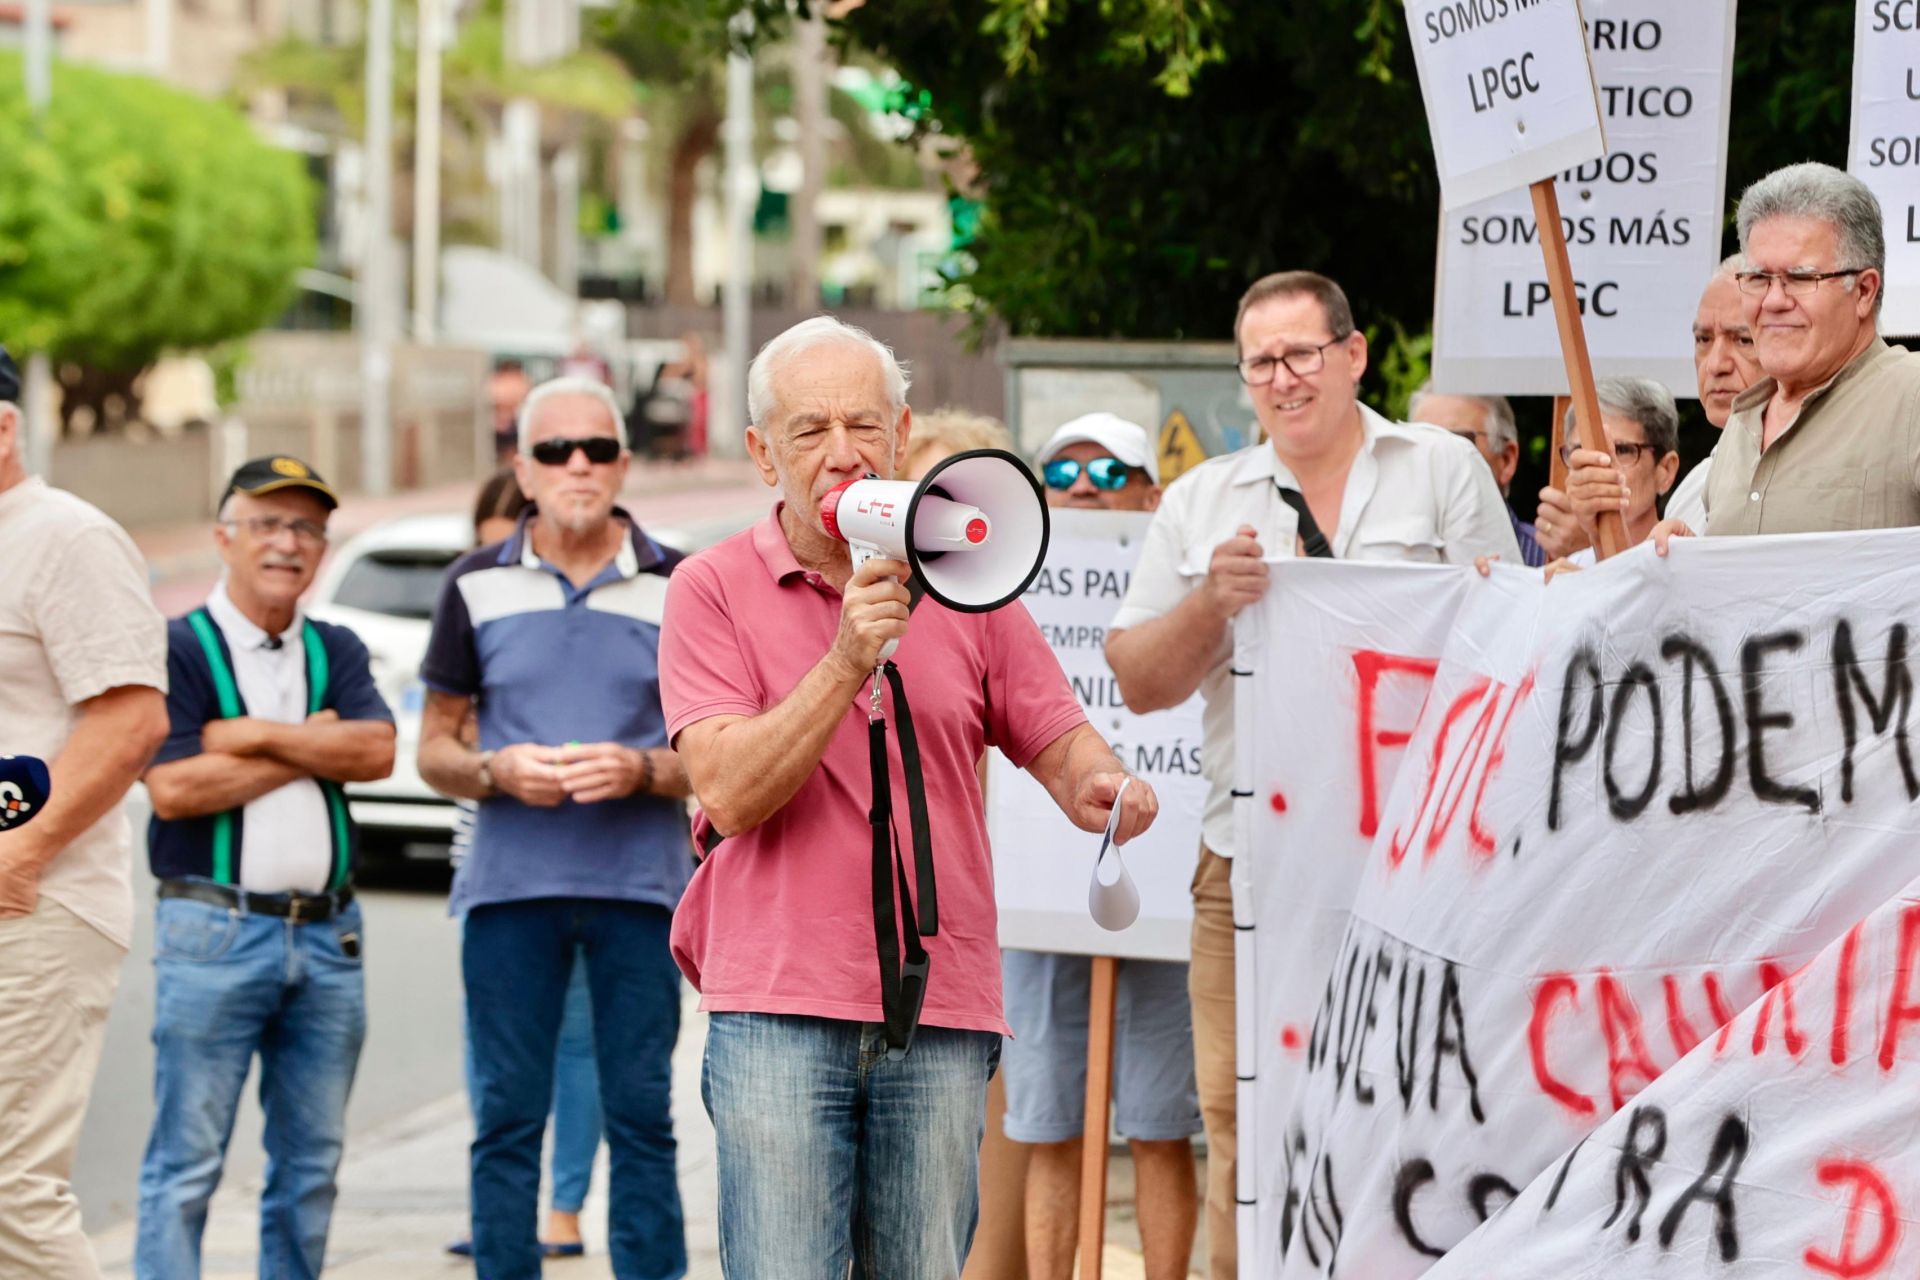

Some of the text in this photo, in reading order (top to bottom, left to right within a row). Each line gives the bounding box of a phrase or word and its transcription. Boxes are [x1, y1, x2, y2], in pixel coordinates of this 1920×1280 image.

[1425, 0, 1509, 44] SOMOS
[1872, 0, 1920, 32] SC
[1583, 19, 1662, 51] RIO
[1467, 51, 1540, 113] LPGC
[1601, 85, 1693, 118] TICO
[1552, 152, 1658, 183] DOS
[1869, 136, 1920, 167] SO
[1608, 209, 1691, 246] MÁS
[1546, 618, 1920, 832] PODEM
[1136, 739, 1203, 775] MÁS
